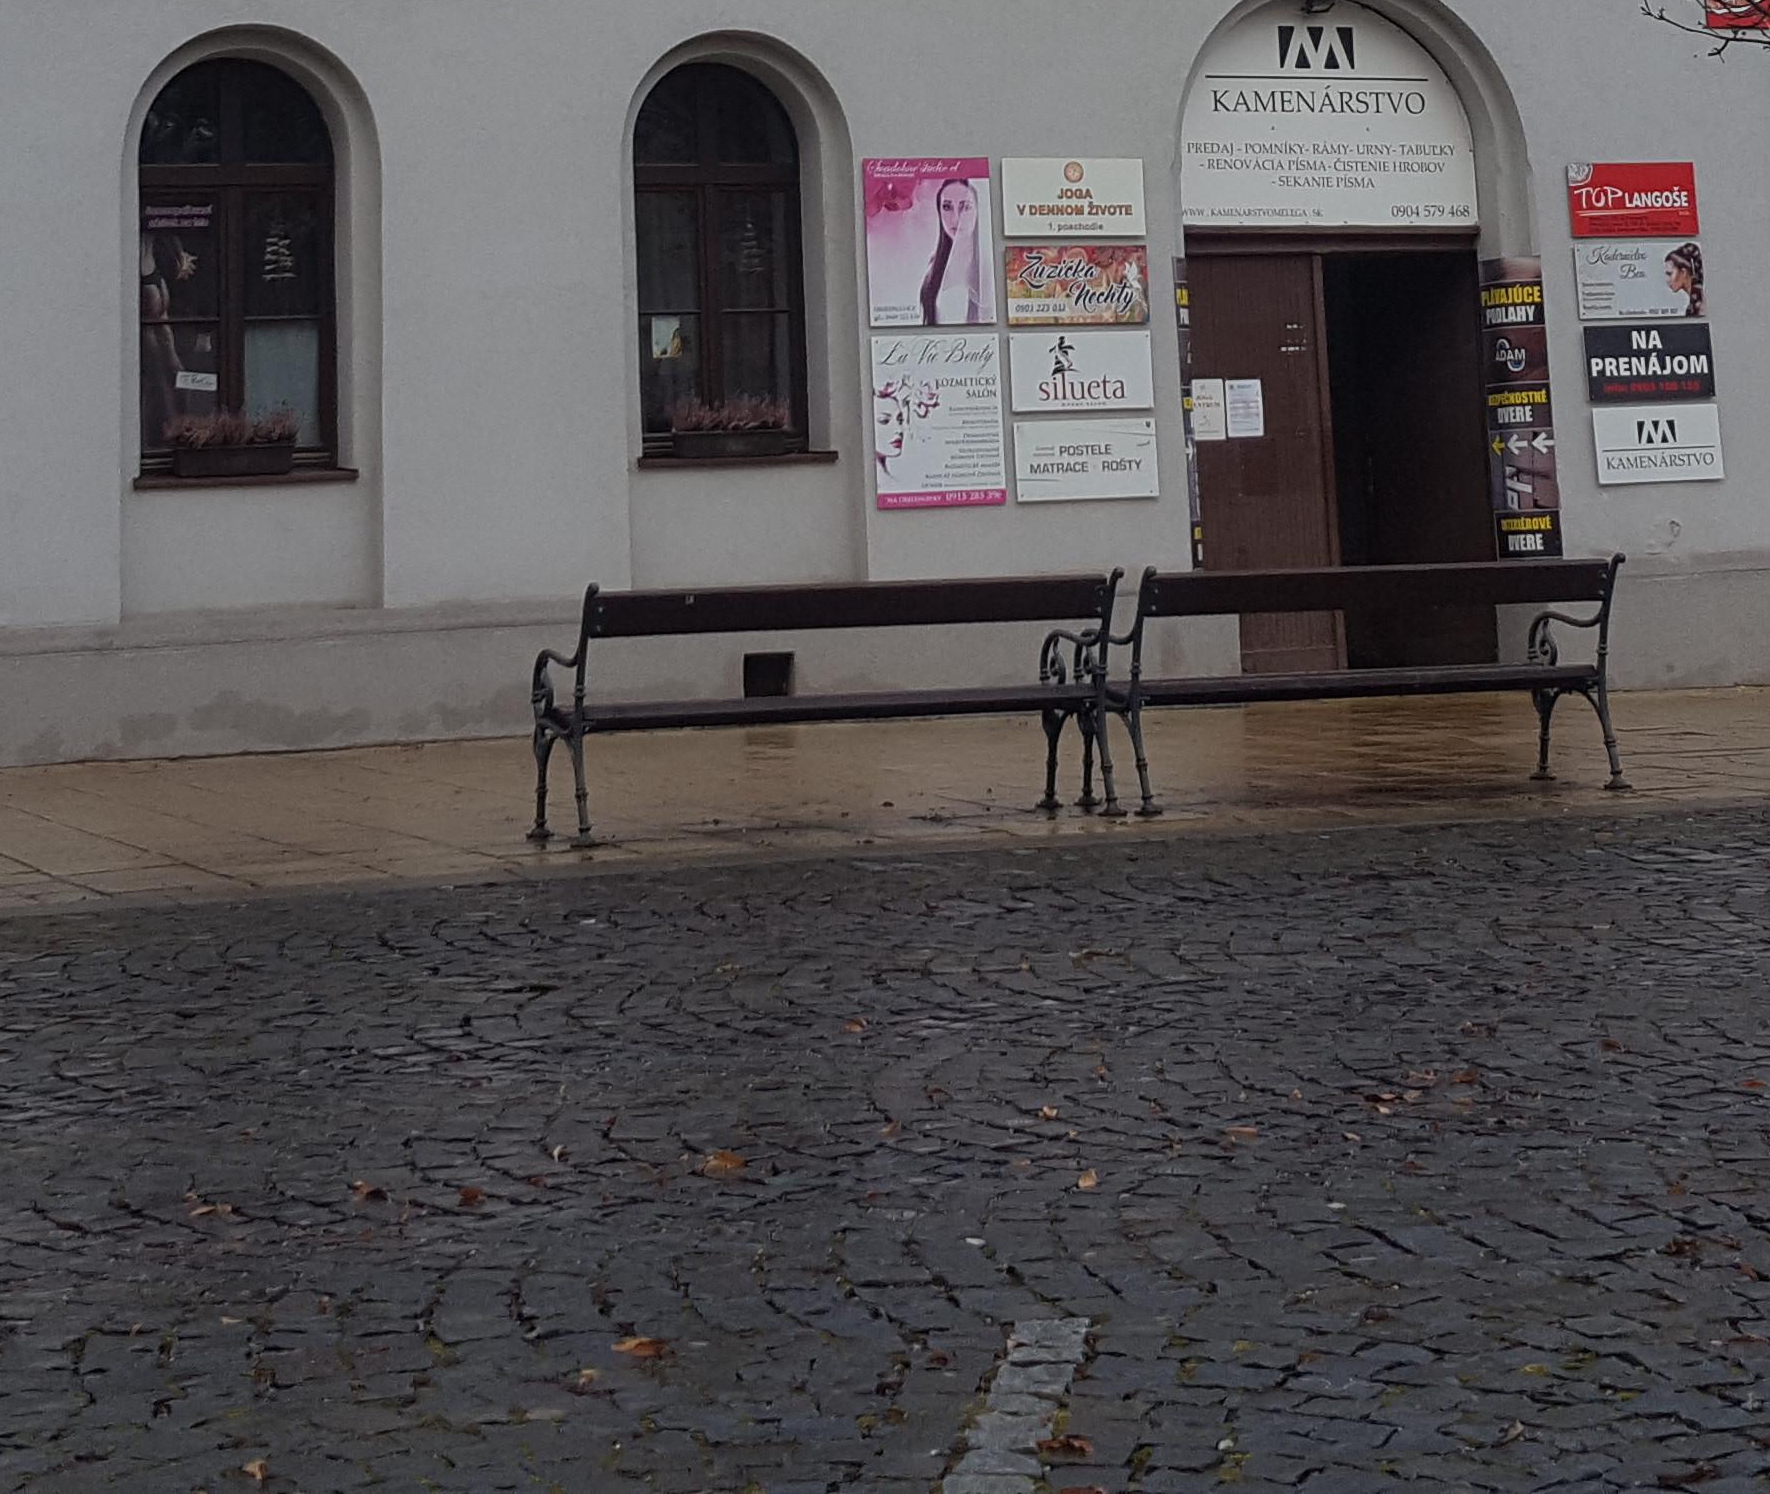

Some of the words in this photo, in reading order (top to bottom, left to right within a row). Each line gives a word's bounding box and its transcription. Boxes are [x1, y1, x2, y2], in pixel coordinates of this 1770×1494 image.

[1210, 84, 1426, 115] KAMENÁRSTVO
[1186, 141, 1234, 157] PREDAJ
[1392, 161, 1446, 174] HROBOV
[1277, 175, 1334, 188] SEKANIE
[1336, 174, 1376, 189] PÍSMA
[1056, 188, 1094, 200] JOGA
[1573, 185, 1624, 210] TOP
[1624, 185, 1689, 208] LANGOŠE
[1016, 205, 1027, 216] V
[1028, 204, 1085, 216] DENNOM
[1087, 201, 1134, 216] ŽIVOTE
[1390, 205, 1420, 218] 0904
[1423, 205, 1446, 218] 579
[1447, 205, 1470, 218] 468
[1068, 280, 1135, 314] Nechty
[1480, 283, 1542, 307] PLÁVAJÚCE
[1485, 305, 1536, 325] PODLAHY
[1631, 330, 1663, 350] NA
[1495, 348, 1526, 362] ADAM
[1590, 352, 1709, 377] PRENÁJOM
[934, 374, 998, 389] KOZMETICKÝ
[1037, 371, 1128, 402] silueta
[966, 389, 998, 399] SALÓN
[1496, 405, 1534, 424] DVERE
[1058, 443, 1113, 457] POSTELE
[1029, 460, 1090, 475] MATRACE
[1100, 458, 1144, 473] ROŠTY
[1605, 451, 1716, 471] KAMENÁRSTVO
[1508, 533, 1545, 552] DVERE
